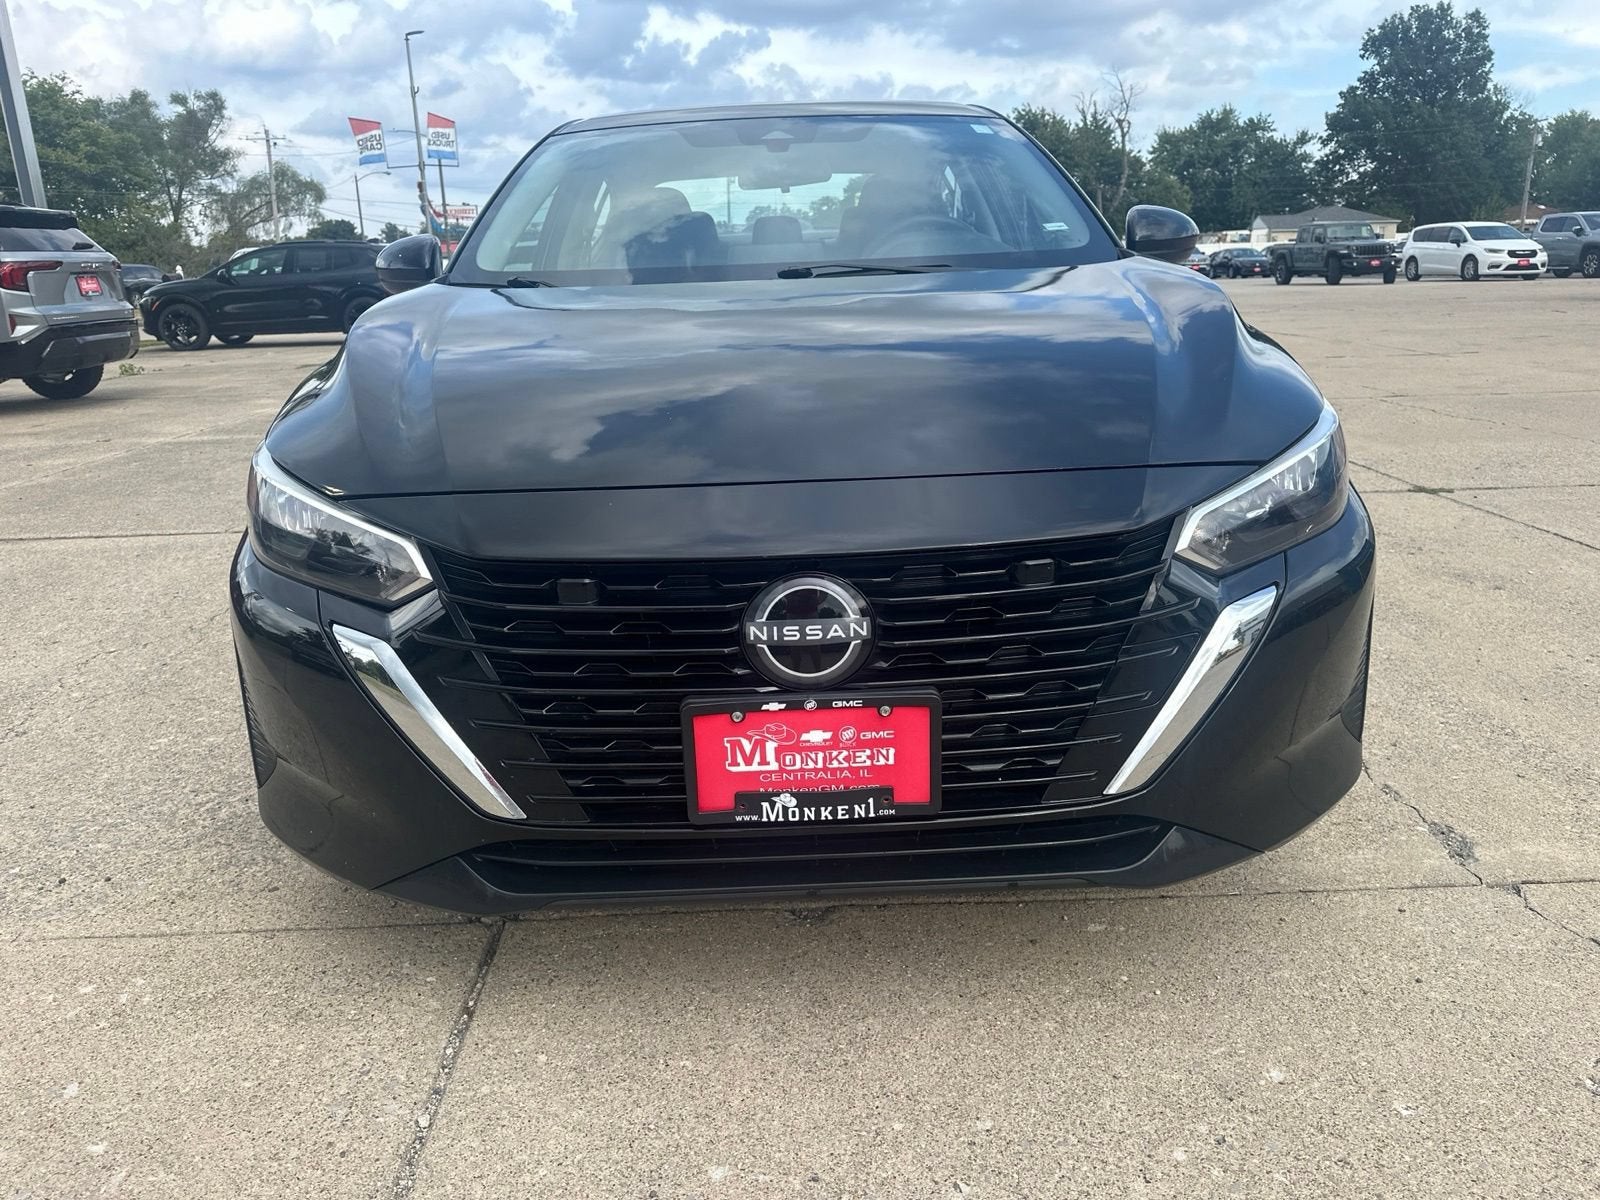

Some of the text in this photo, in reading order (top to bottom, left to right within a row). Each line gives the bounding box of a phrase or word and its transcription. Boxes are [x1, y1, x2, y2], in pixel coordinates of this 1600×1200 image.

[749, 621, 868, 641] NISSAN
[832, 700, 863, 708] GMC
[860, 730, 895, 740] GMC
[724, 736, 896, 772] MONKEN
[760, 771, 856, 782] CENTRALIA,
[760, 784, 880, 792] MonkenGMc
